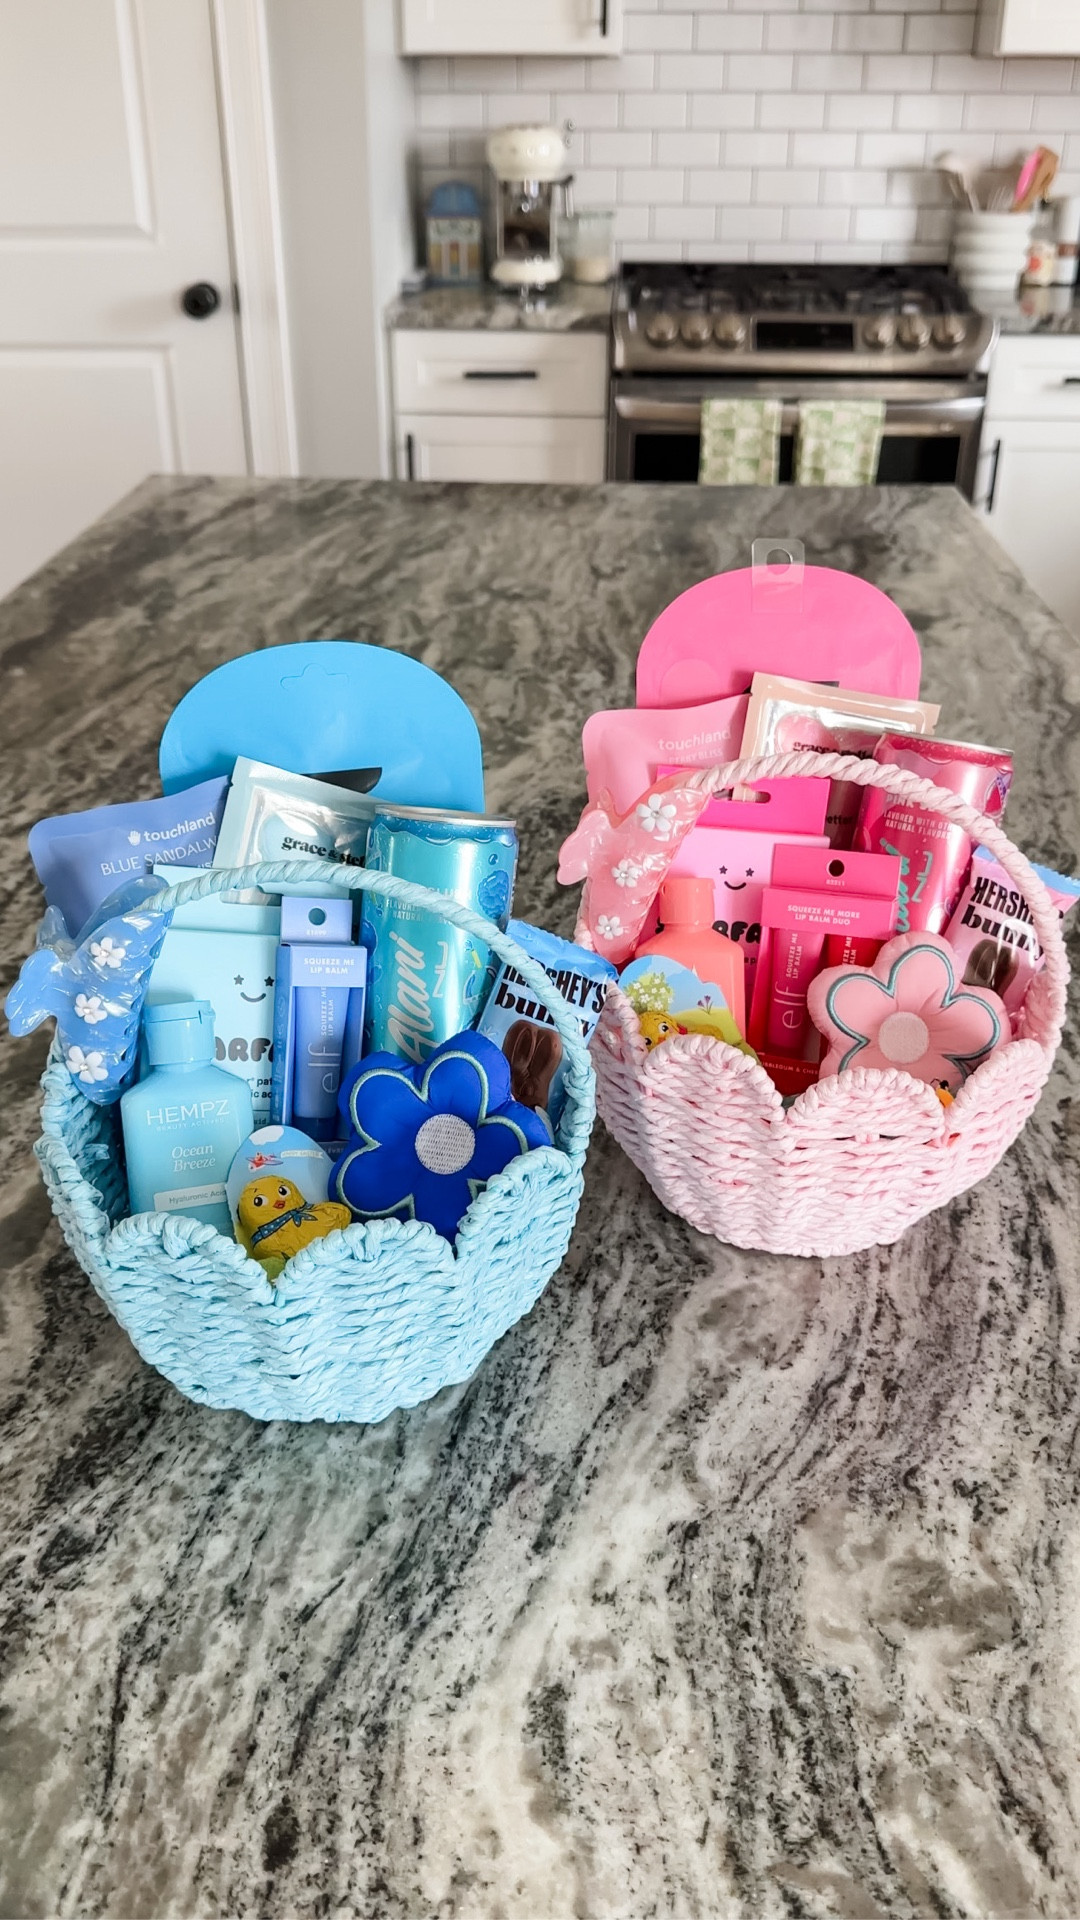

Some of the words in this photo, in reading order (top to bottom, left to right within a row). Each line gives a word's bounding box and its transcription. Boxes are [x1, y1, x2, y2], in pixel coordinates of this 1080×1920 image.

[658, 729, 731, 751] touchland
[143, 812, 216, 842] touchland
[885, 818, 915, 833] NATURAL
[915, 817, 936, 828] WITH
[281, 836, 327, 857] grace
[327, 849, 338, 859] &
[100, 856, 142, 876] BLUE
[787, 904, 821, 915] SQUEEZE
[823, 908, 835, 916] ME
[837, 910, 861, 919] MORE
[808, 914, 831, 924] BALM
[832, 917, 851, 926] DUO
[303, 957, 340, 966] SQUEEZE
[786, 946, 796, 978] SQUEEZE
[791, 933, 798, 944] ME
[794, 945, 803, 966] BALM
[310, 966, 323, 974] LIP
[325, 967, 349, 975] BALM
[388, 931, 441, 1065] Alani
[146, 1099, 230, 1126] HEMPZ
[172, 1145, 214, 1159] Ocean
[173, 1158, 216, 1173] Breeze
[169, 1192, 208, 1205] Hyaluronic
